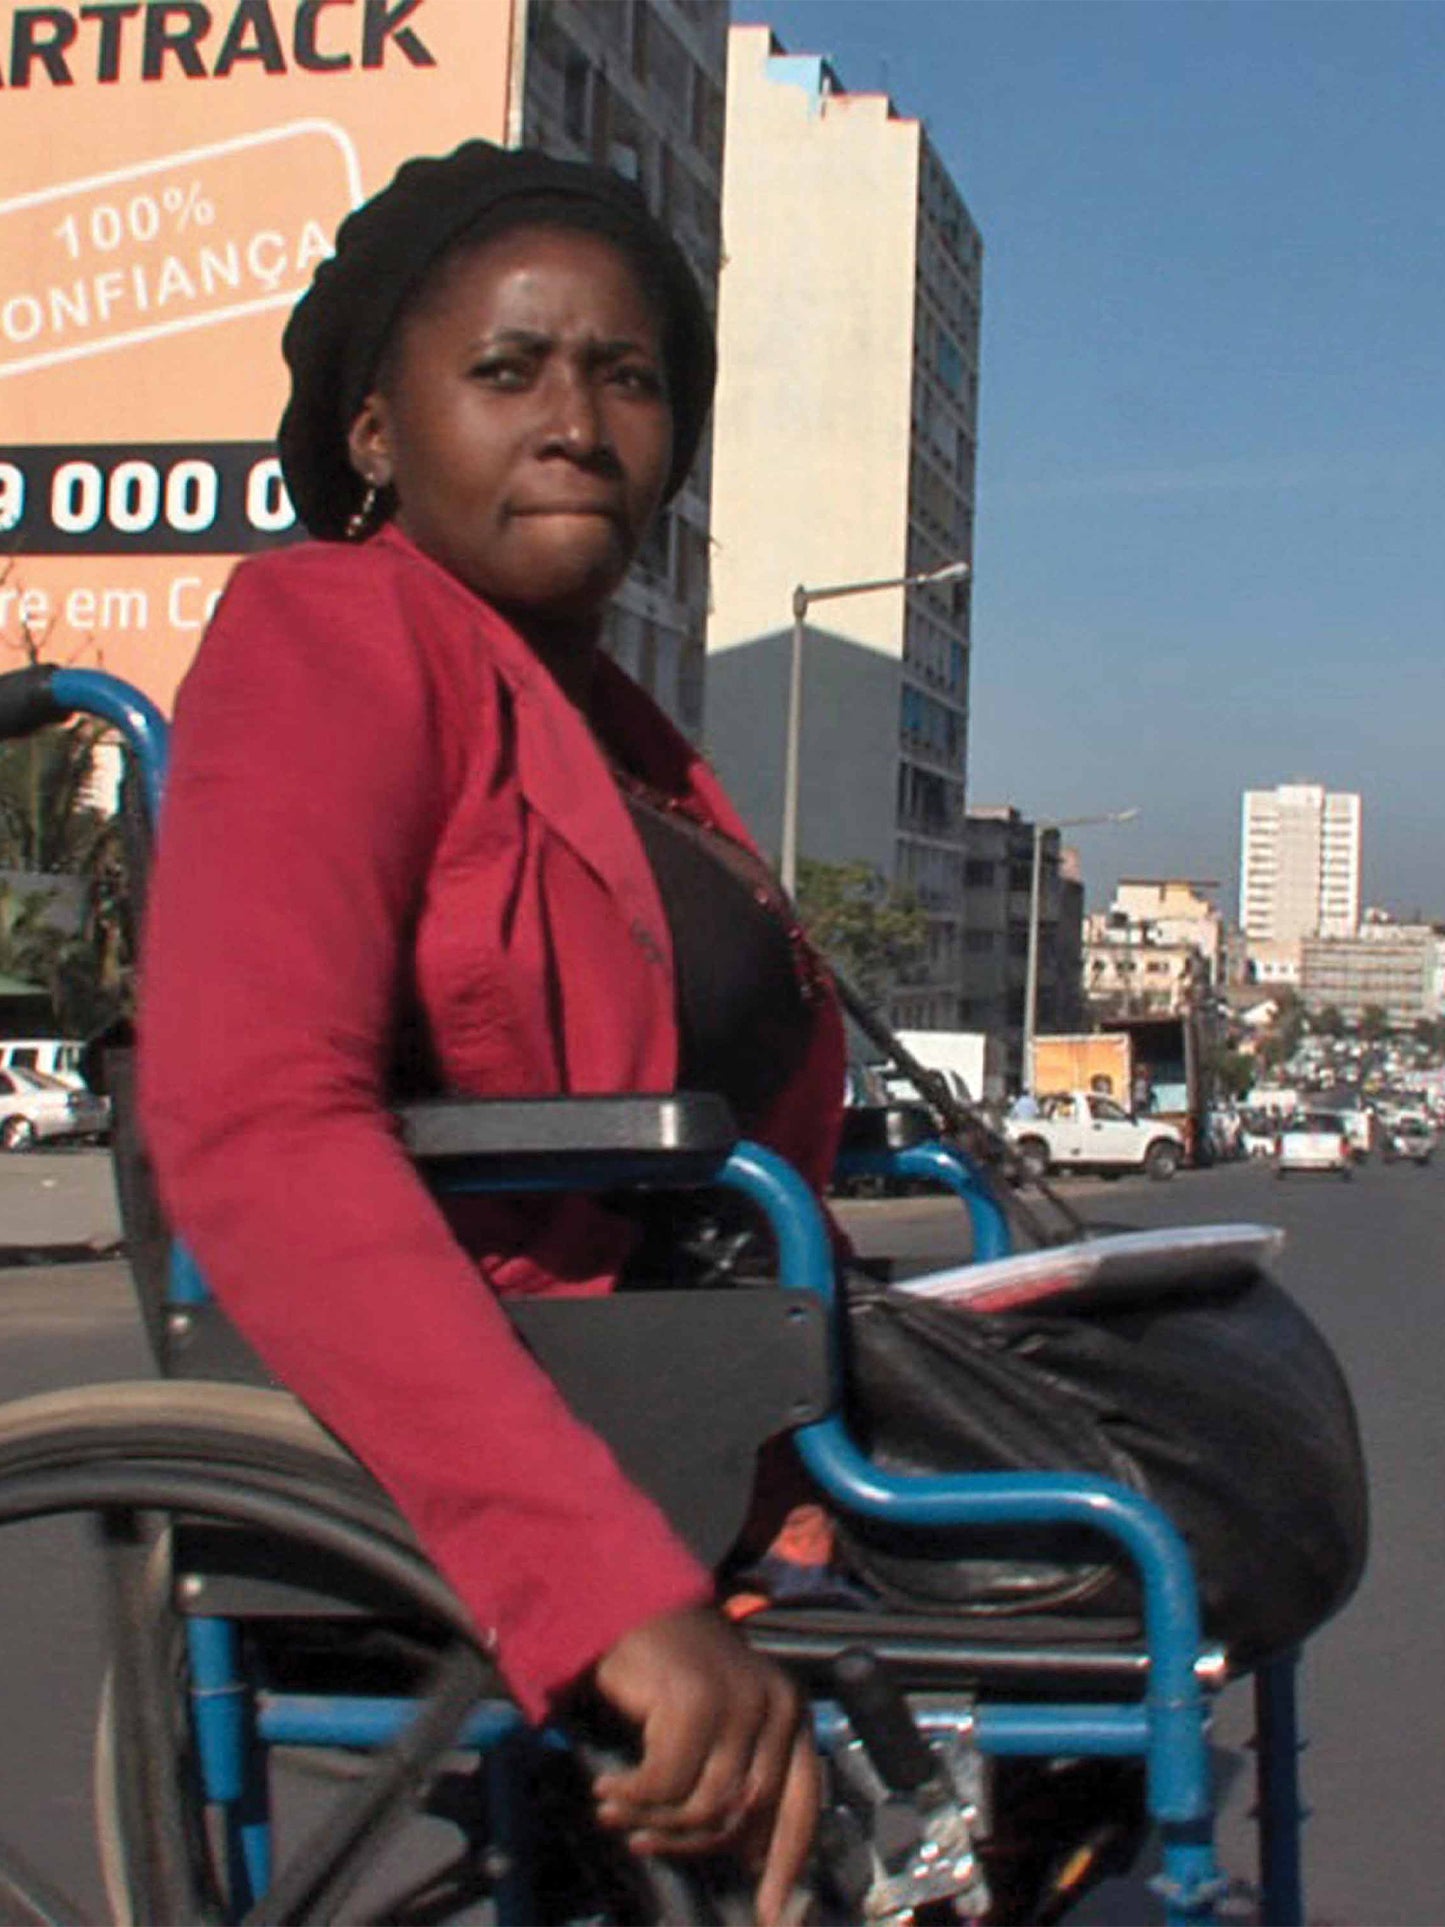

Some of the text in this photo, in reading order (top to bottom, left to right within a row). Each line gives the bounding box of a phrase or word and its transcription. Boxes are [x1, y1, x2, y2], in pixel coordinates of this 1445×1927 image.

[0, 0, 437, 88] RTRACK
[54, 179, 216, 261] 100%
[1, 219, 337, 343] ONFIANÇA
[51, 459, 219, 534] 000
[245, 456, 297, 532] 0
[65, 588, 149, 630] em
